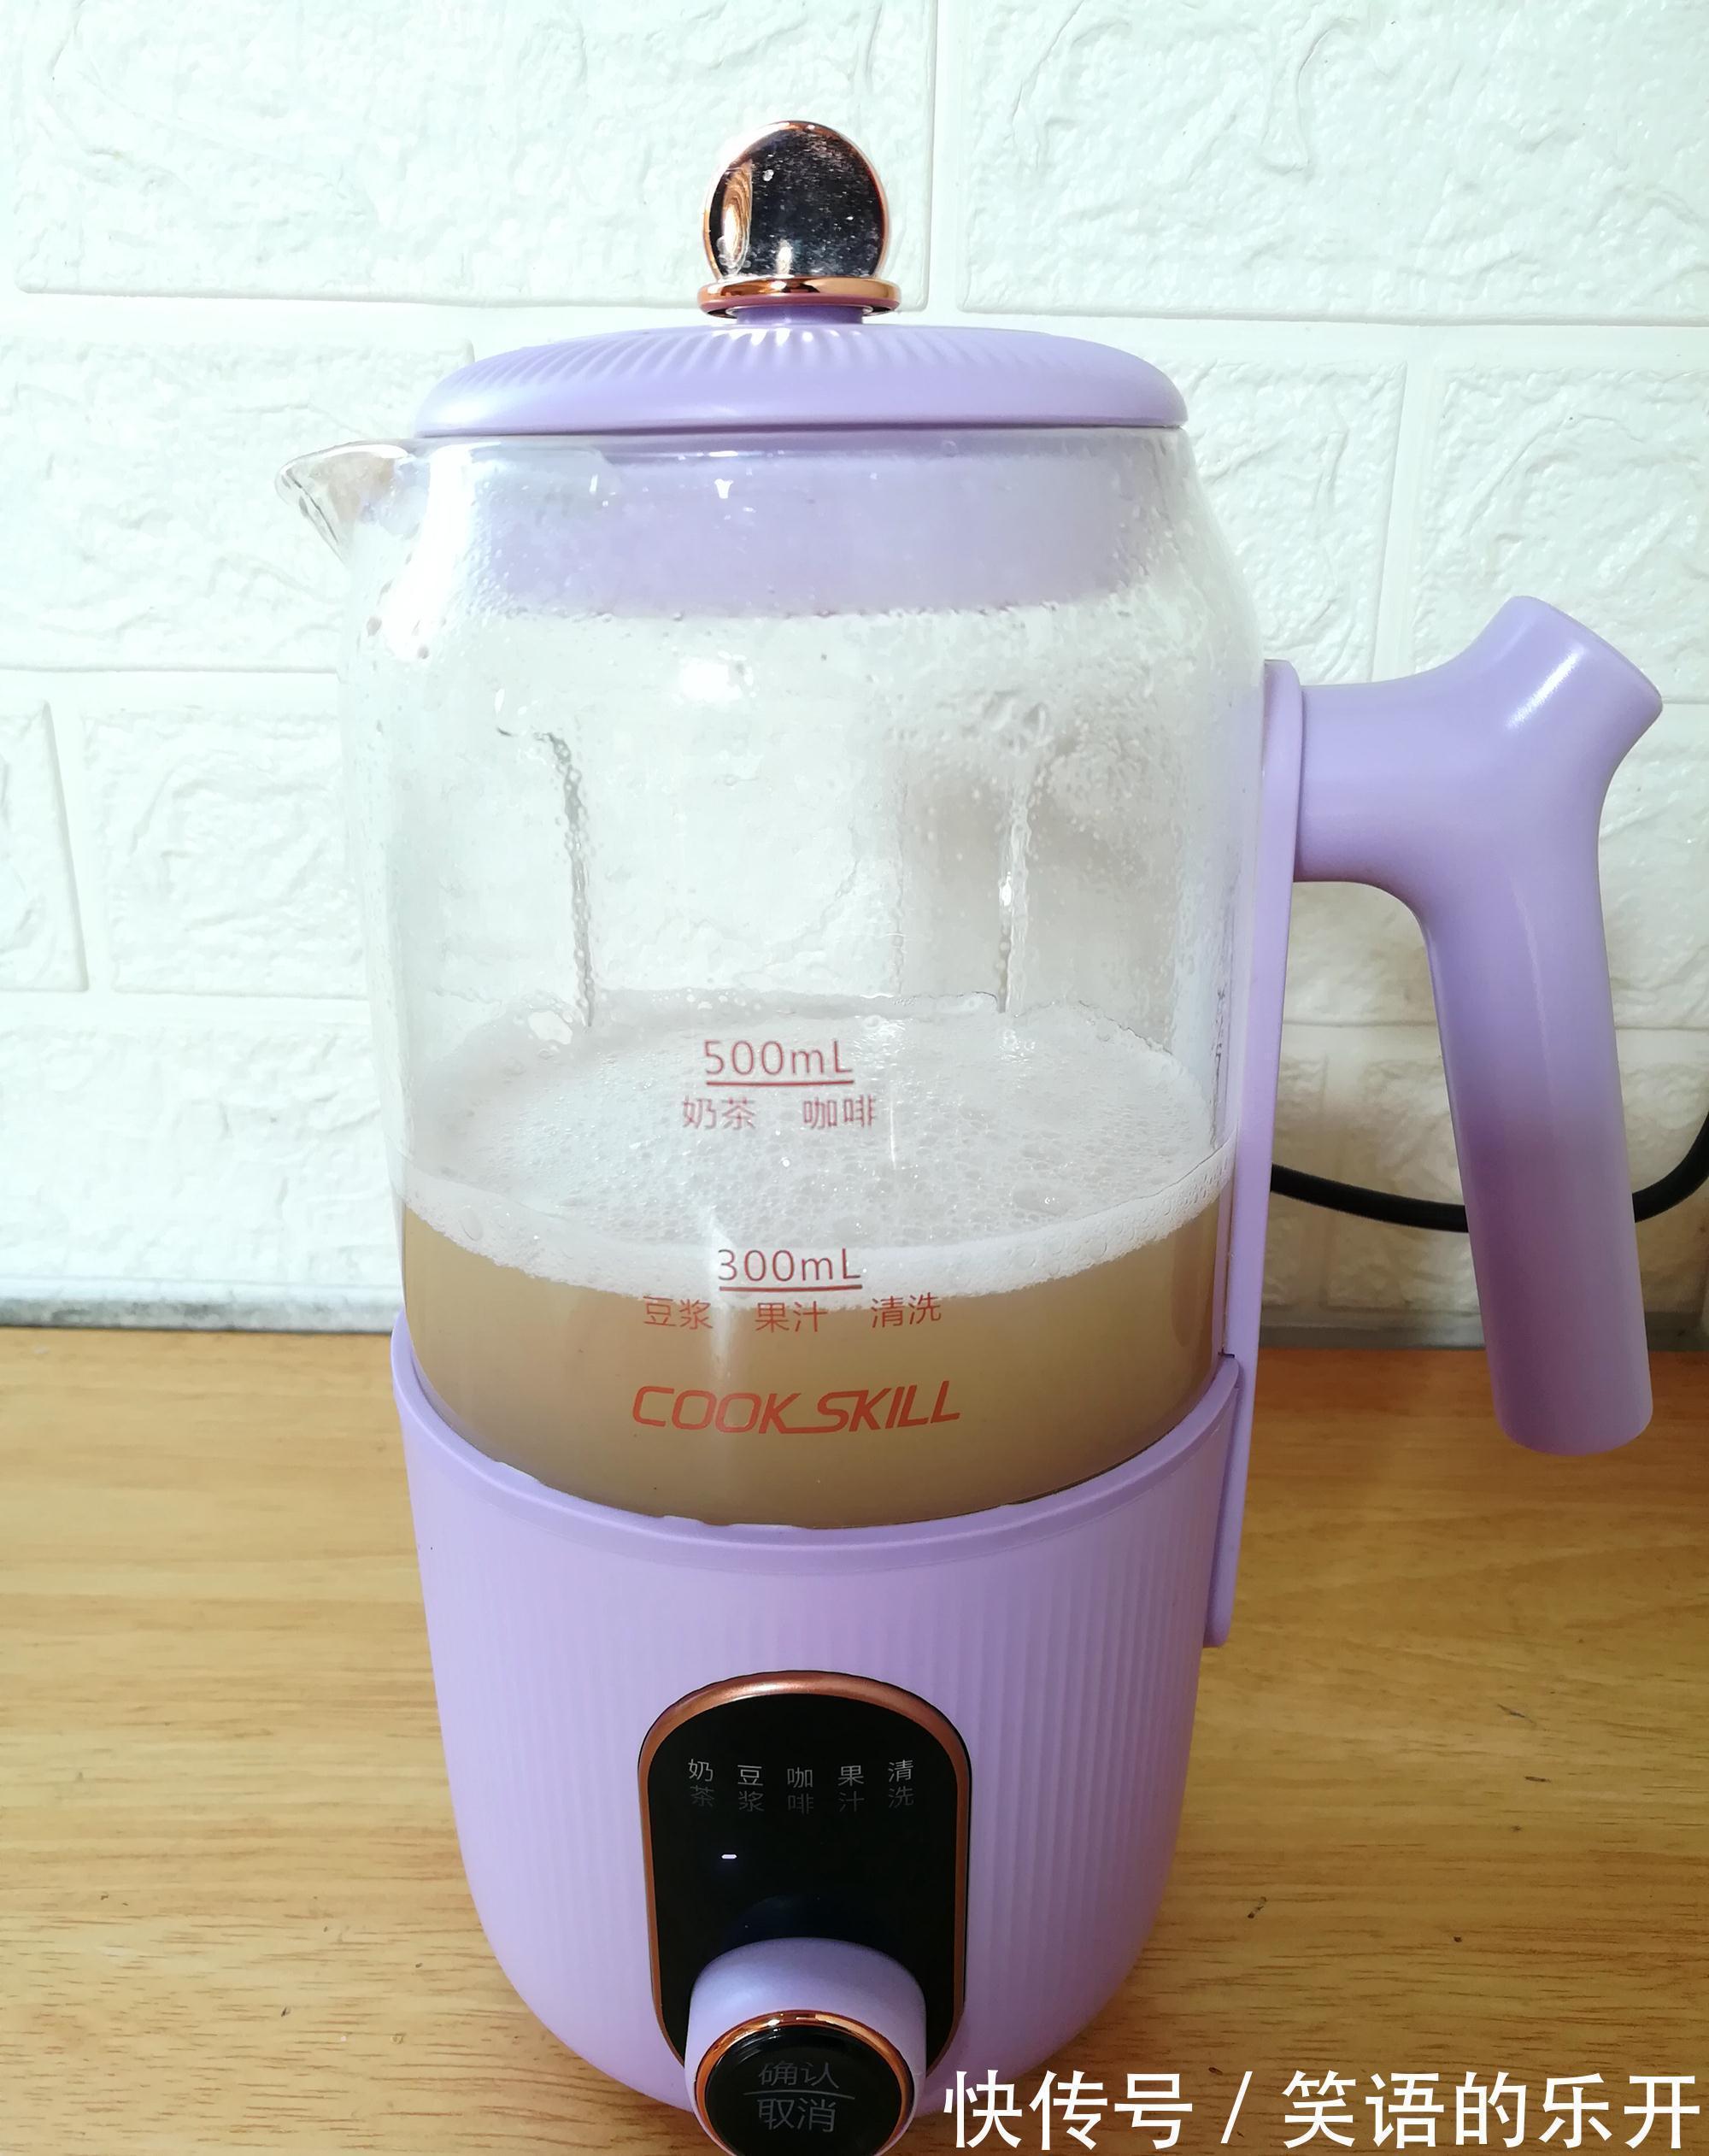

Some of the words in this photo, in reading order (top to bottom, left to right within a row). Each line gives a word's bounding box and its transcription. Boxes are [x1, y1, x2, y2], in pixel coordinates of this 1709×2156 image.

[703, 1038, 854, 1075] 500mL
[682, 1095, 756, 1130] 奶茶
[802, 1094, 877, 1129] 咖啡
[718, 1248, 861, 1282] 300mL
[643, 1295, 713, 1331] 豆浆
[755, 1301, 828, 1333] 果汁
[870, 1292, 942, 1328] 清洗
[632, 1385, 802, 1435] COOK
[816, 1380, 960, 1434] SKILL
[688, 1758, 714, 1807] 奶茶
[737, 1764, 765, 1812] 豆浆
[787, 1766, 813, 1814] 咖啡
[837, 1765, 865, 1812] 果汁
[888, 1759, 914, 1809] 清洗
[758, 2060, 840, 2088] 确认
[757, 2097, 837, 2132] 取消
